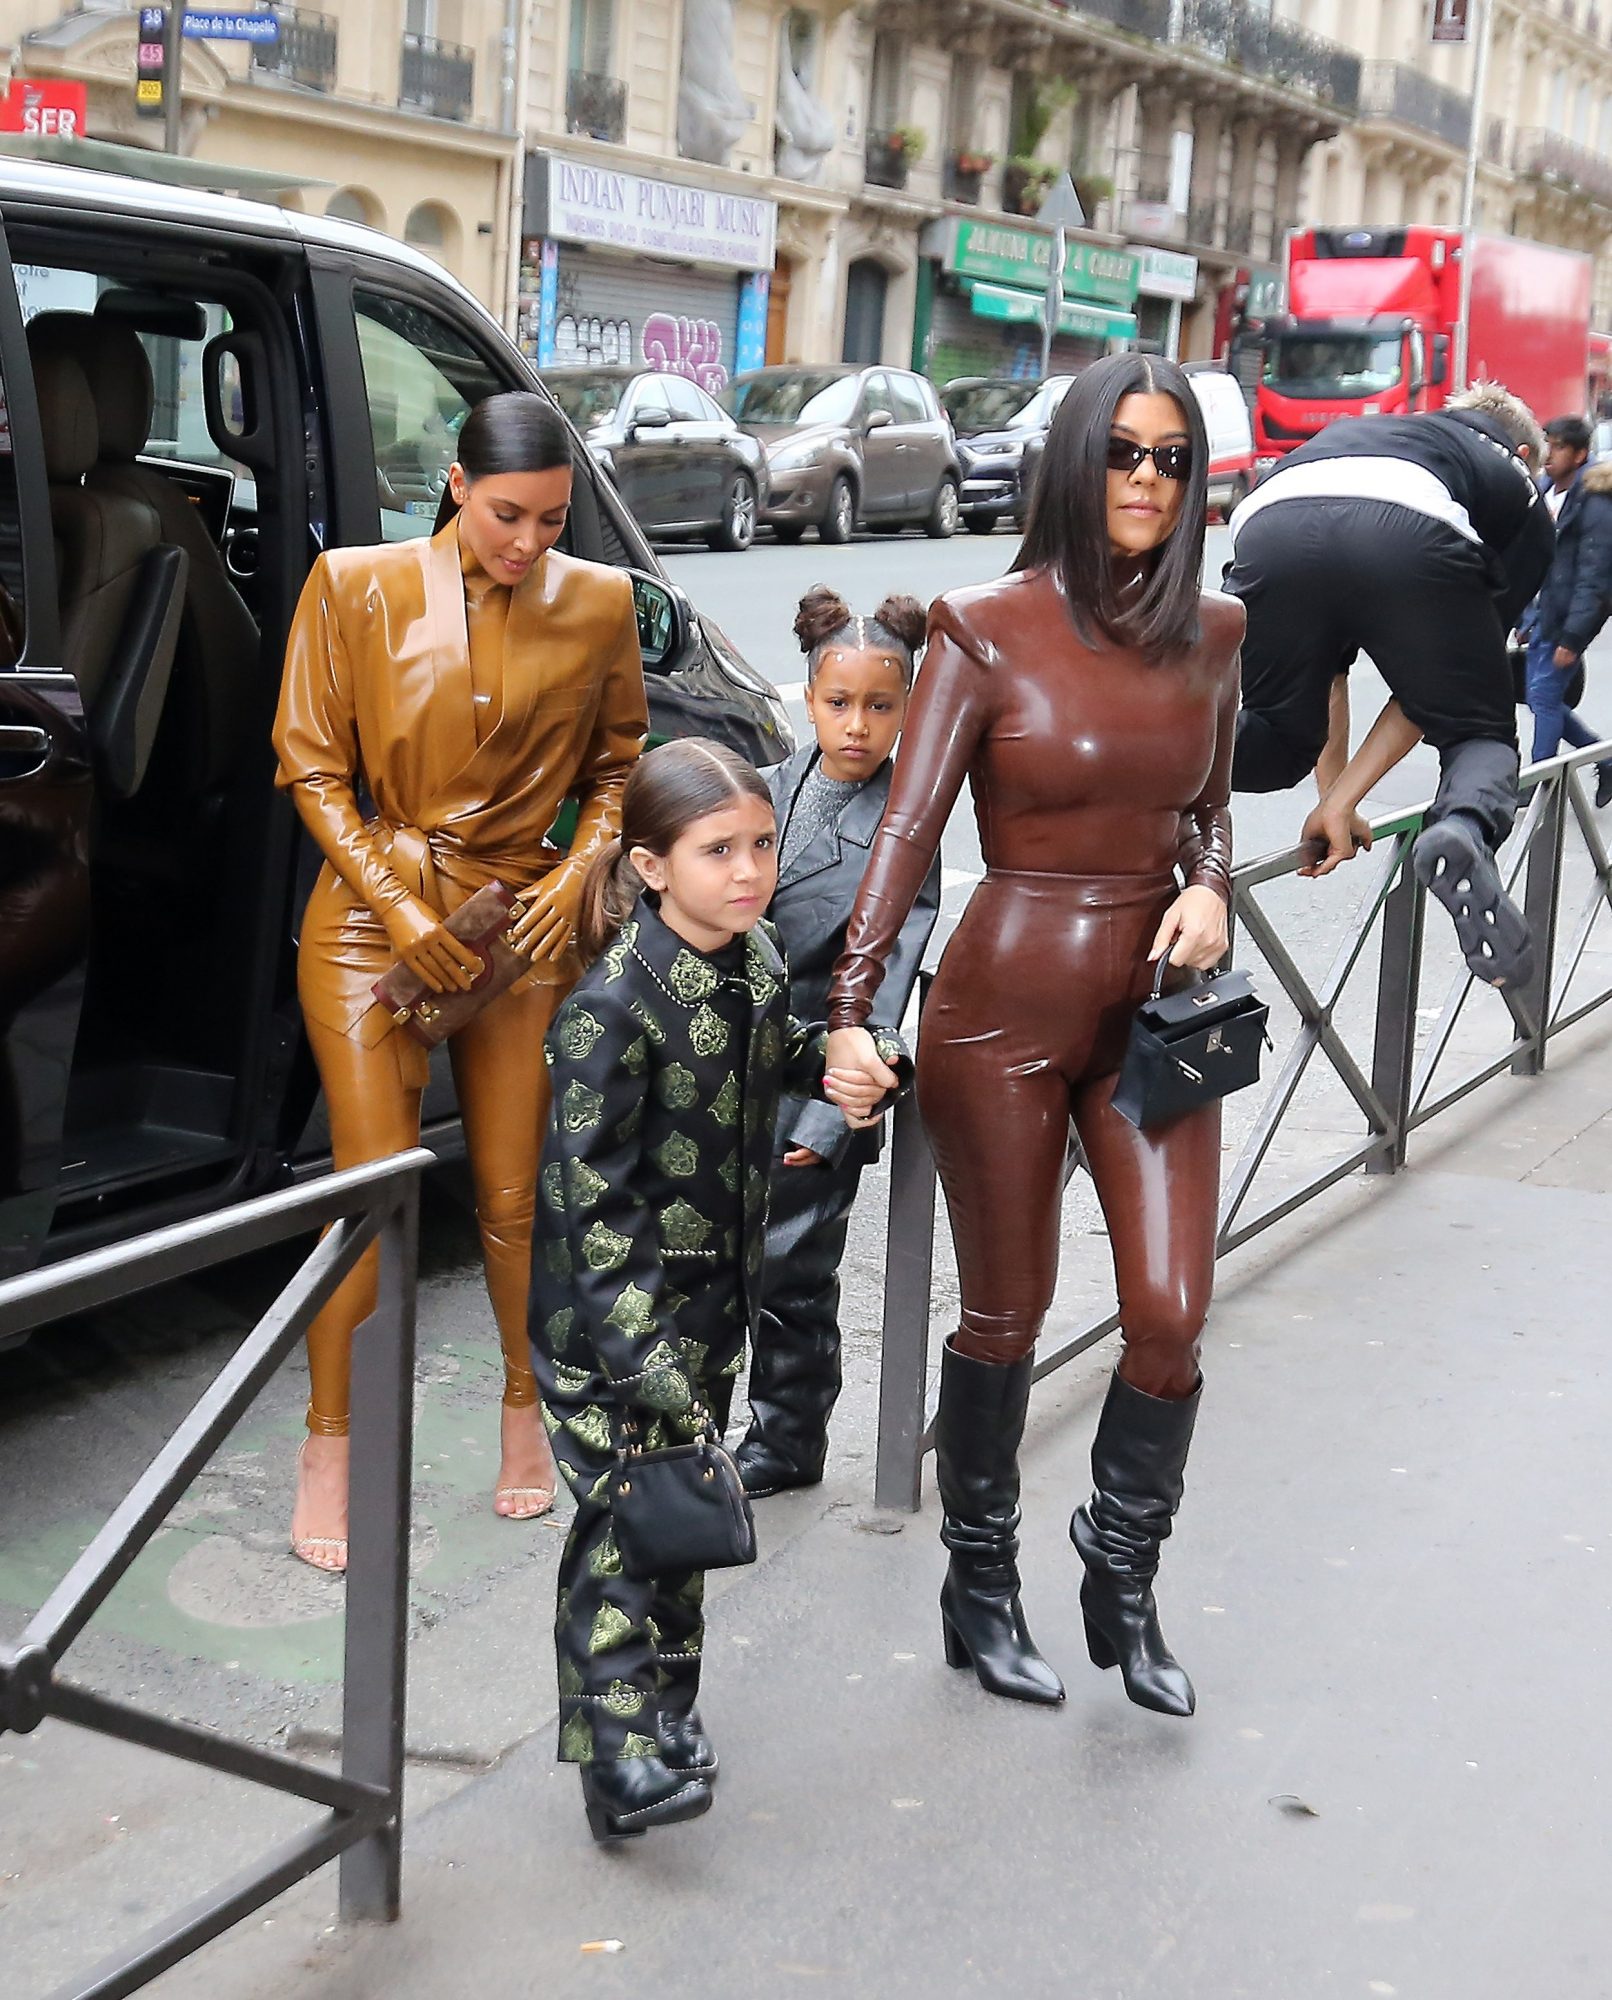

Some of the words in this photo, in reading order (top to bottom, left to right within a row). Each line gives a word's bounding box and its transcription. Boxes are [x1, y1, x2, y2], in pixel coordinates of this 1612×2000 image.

[144, 8, 162, 25] 38
[185, 15, 210, 29] Place
[211, 16, 224, 29] de
[225, 17, 234, 30] la
[235, 18, 277, 33] Chapelle
[143, 45, 161, 60] 45
[23, 106, 77, 136] SFR
[560, 164, 624, 212] INDIAN
[638, 181, 705, 229] PUNJABI
[716, 195, 767, 237] MUSIC
